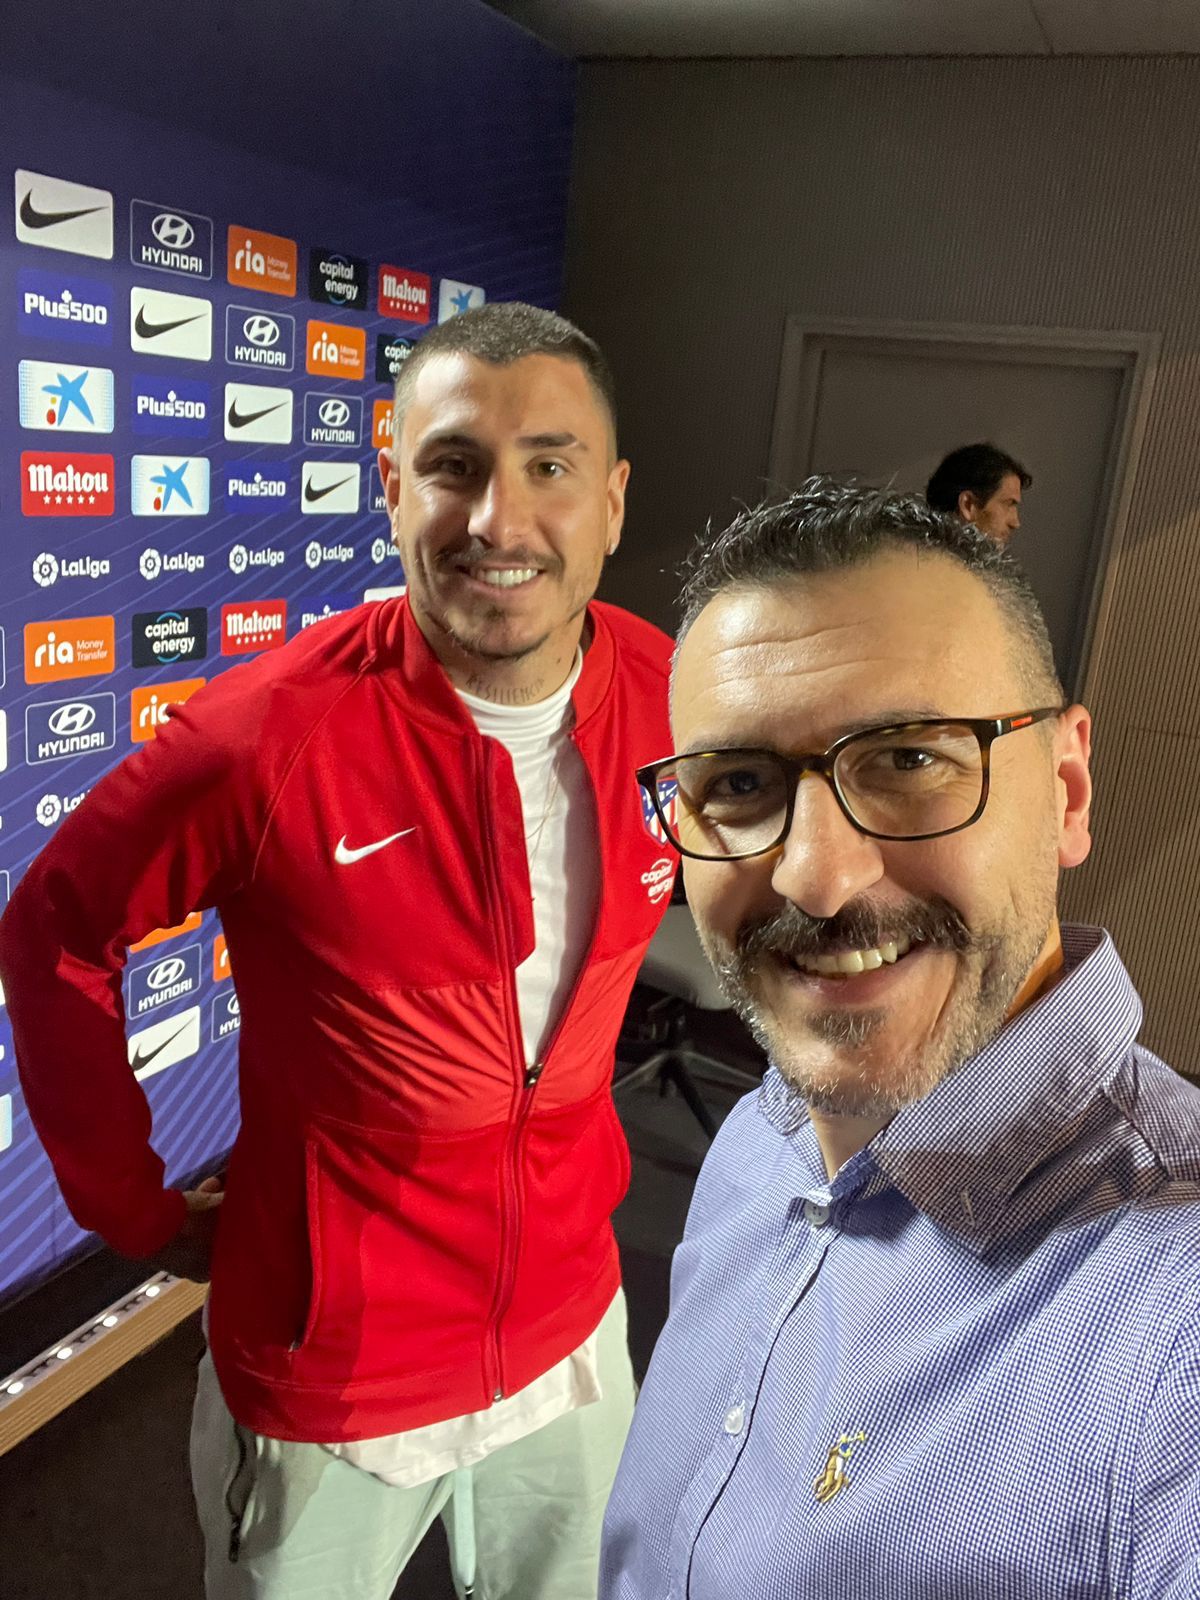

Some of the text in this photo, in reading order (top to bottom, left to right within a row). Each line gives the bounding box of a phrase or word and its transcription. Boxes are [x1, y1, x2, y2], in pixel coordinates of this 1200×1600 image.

[142, 245, 203, 273] HYUNDAI
[235, 239, 265, 276] ria
[319, 260, 354, 281] capital
[324, 279, 358, 300] energy
[382, 274, 427, 305] Mahou
[24, 290, 108, 325] Plus500
[234, 345, 286, 366] HYUNDAI
[312, 331, 338, 364] ria
[384, 344, 414, 362] capit
[137, 390, 206, 419] Plus500
[311, 428, 355, 443] HYUNDAI
[28, 463, 109, 493] Mahou
[228, 472, 286, 497] Plus500
[163, 552, 205, 573] LaLiga
[249, 548, 285, 567] LaLiga
[322, 544, 354, 562] LaLiga
[61, 556, 110, 579] LaLiga
[144, 617, 189, 639] capital
[226, 610, 282, 637] Mahou
[34, 631, 74, 668] ria
[76, 639, 104, 651] Money
[76, 648, 108, 662] Transfer
[152, 636, 196, 655] energy
[38, 732, 104, 758] HYUNDAI
[138, 977, 193, 1012] HYUNDAI
